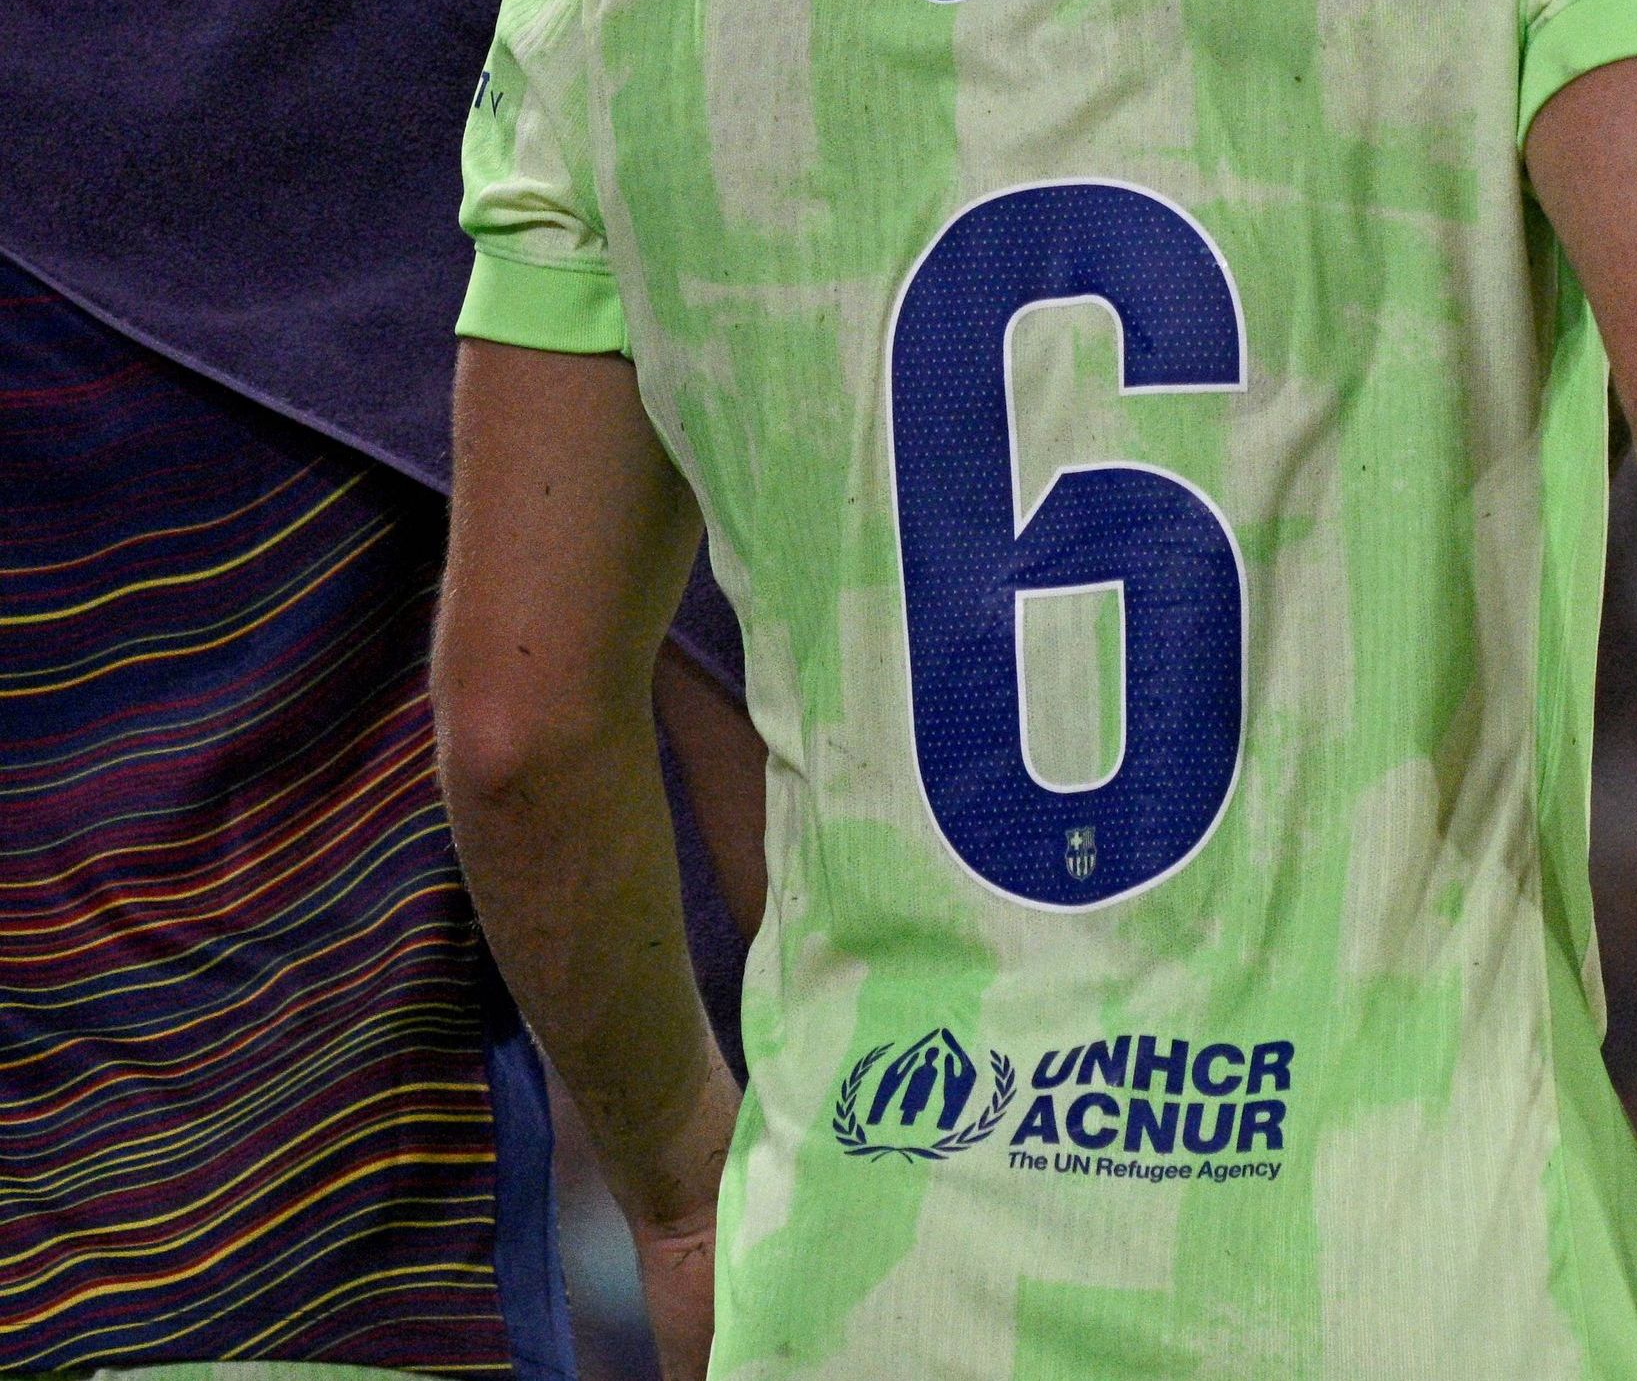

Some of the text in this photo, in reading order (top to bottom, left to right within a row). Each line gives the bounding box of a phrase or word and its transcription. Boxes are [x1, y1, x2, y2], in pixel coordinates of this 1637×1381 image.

[886, 177, 1248, 914] 6
[1031, 1034, 1295, 1096] UNHCR
[1009, 1092, 1287, 1154] ACNUR
[1007, 1152, 1282, 1182] The UN Refugee Agency
